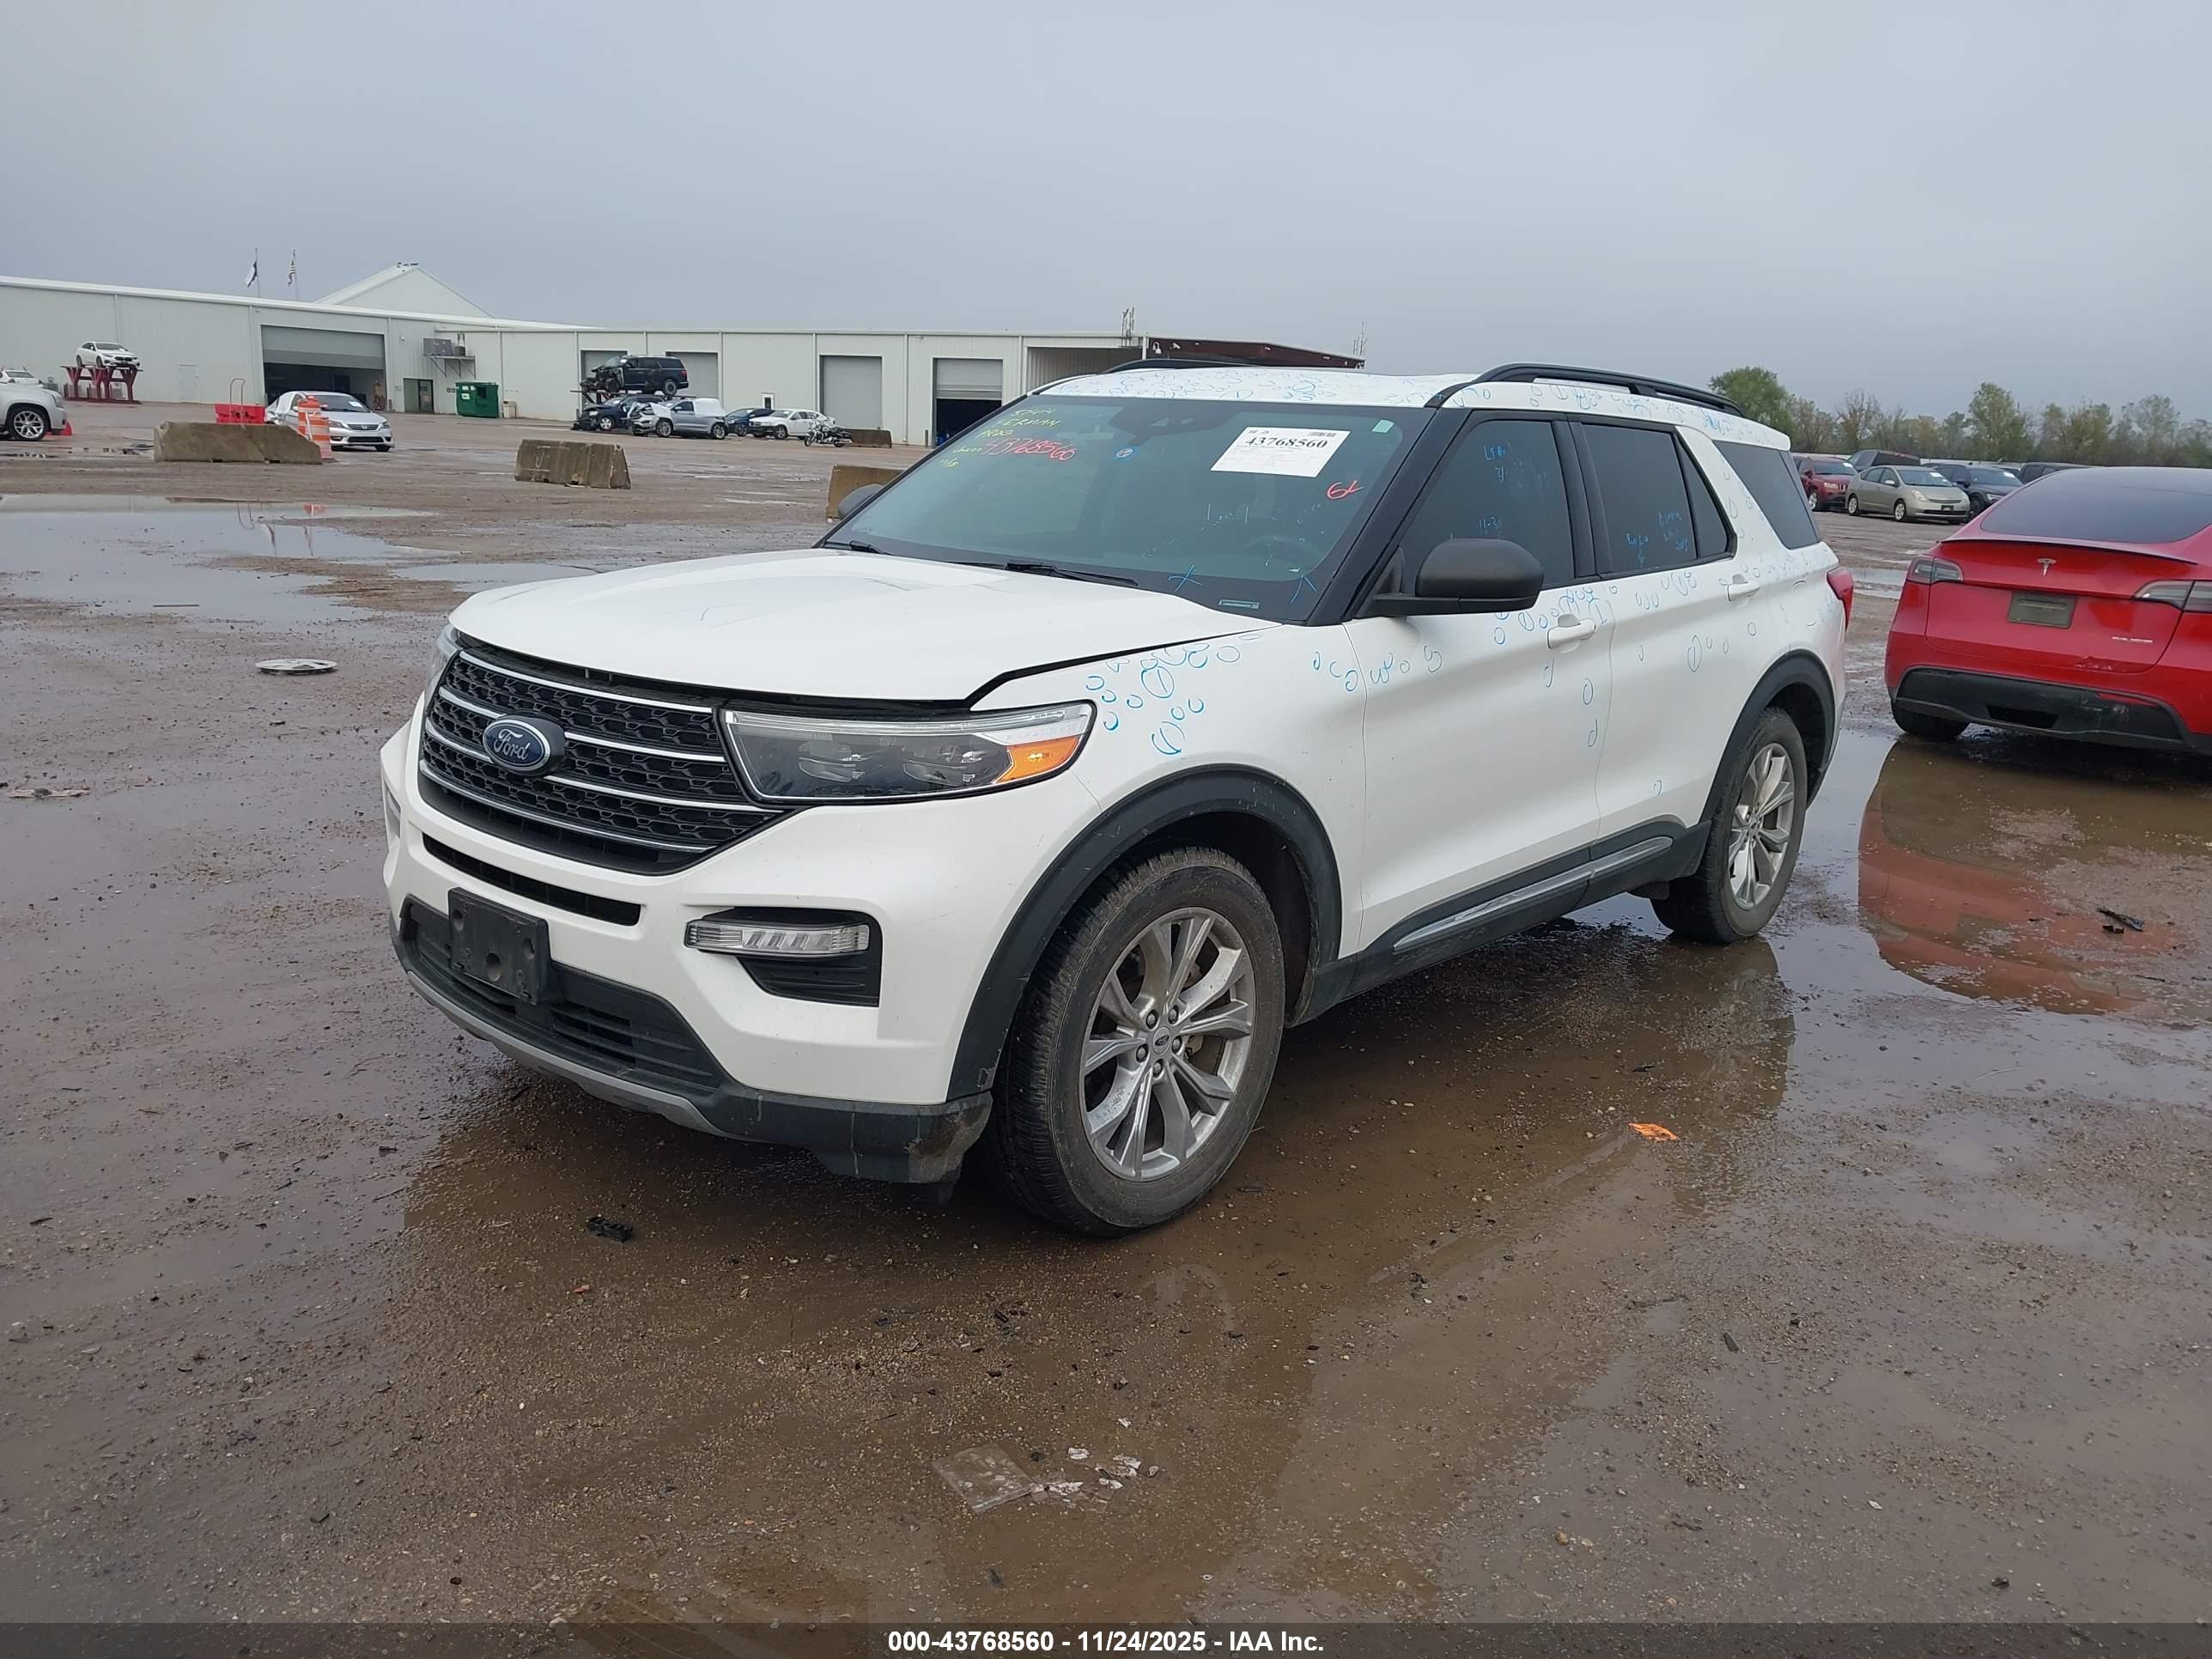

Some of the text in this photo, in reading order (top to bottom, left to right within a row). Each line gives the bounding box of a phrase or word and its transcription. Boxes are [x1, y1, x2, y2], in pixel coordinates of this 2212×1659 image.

[982, 438, 1077, 461] 43768560
[1245, 436, 1328, 448] 43768560
[493, 728, 532, 761] Ford
